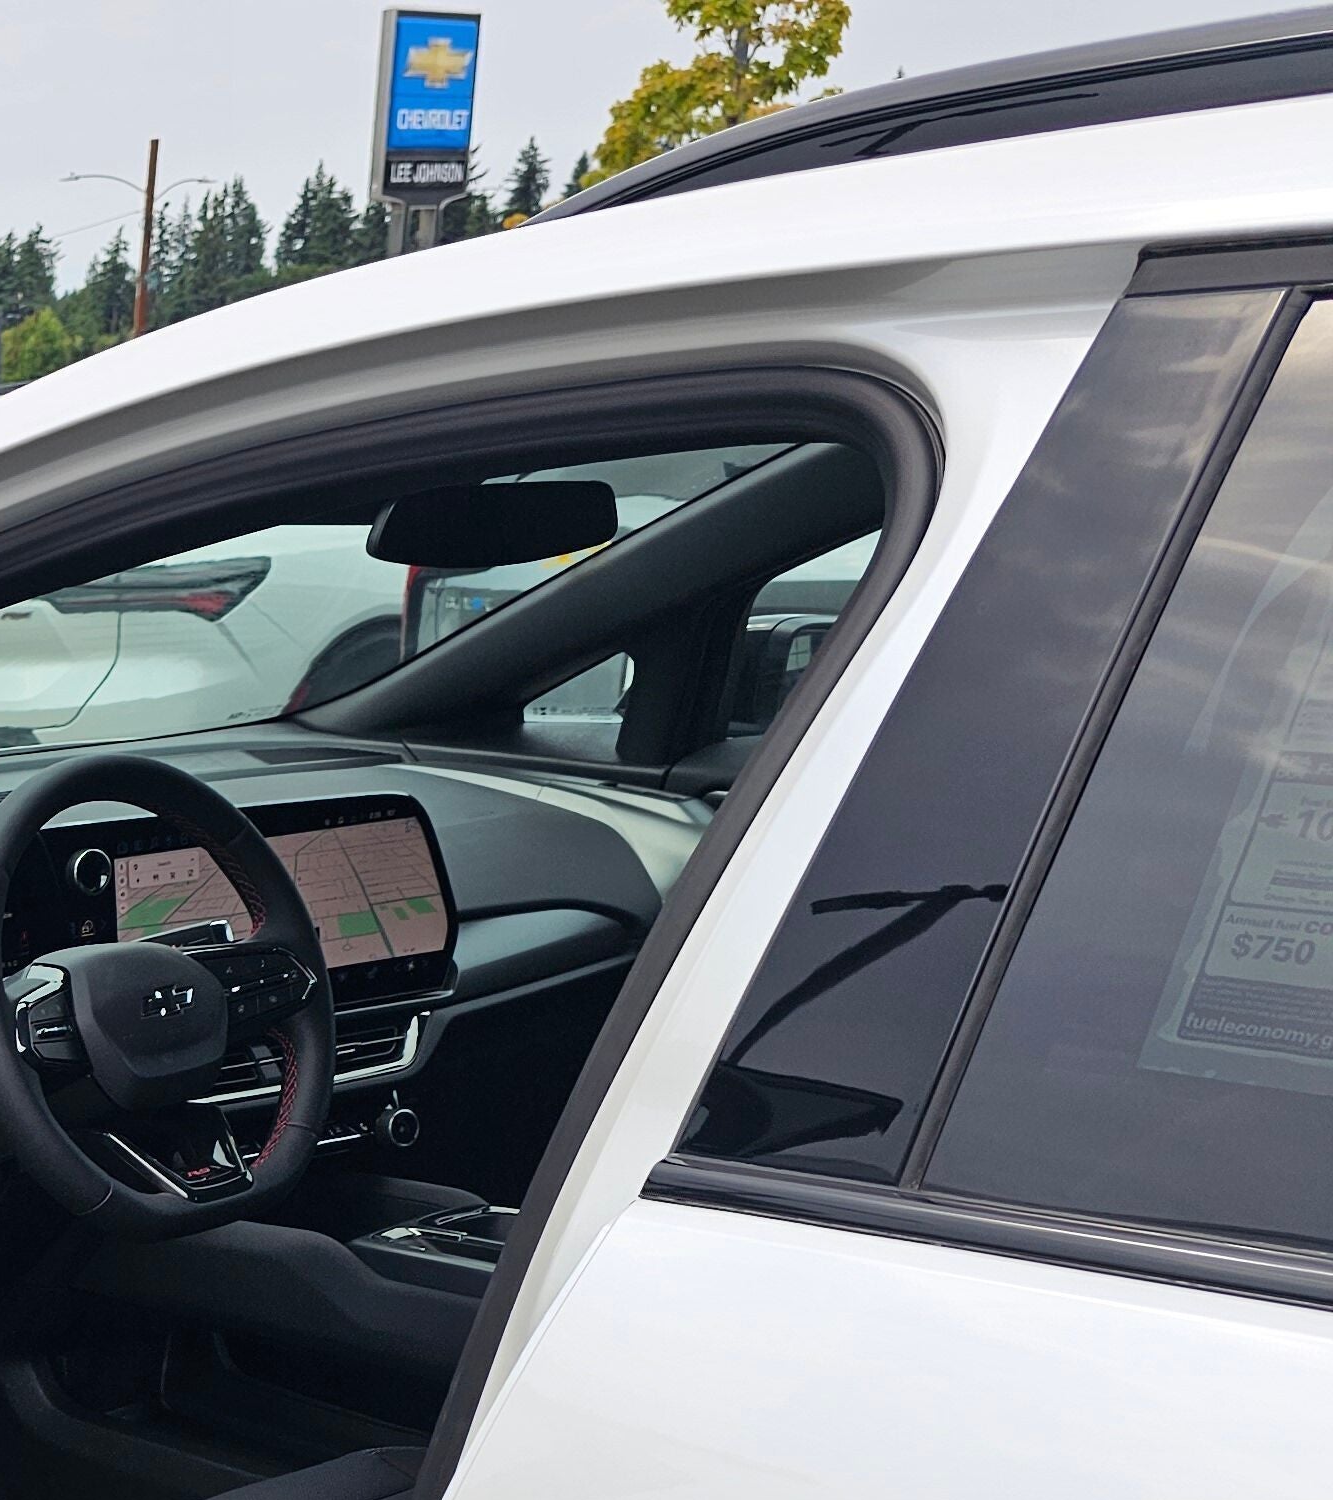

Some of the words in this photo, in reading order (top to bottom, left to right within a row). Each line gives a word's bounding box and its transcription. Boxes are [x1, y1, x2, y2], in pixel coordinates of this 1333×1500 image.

[396, 108, 469, 130] CHEVROLET
[389, 162, 413, 183] LEE
[413, 163, 465, 183] JOHNSON
[1225, 913, 1273, 929] Annual
[1275, 919, 1302, 931] fuel
[1230, 931, 1316, 966] $750
